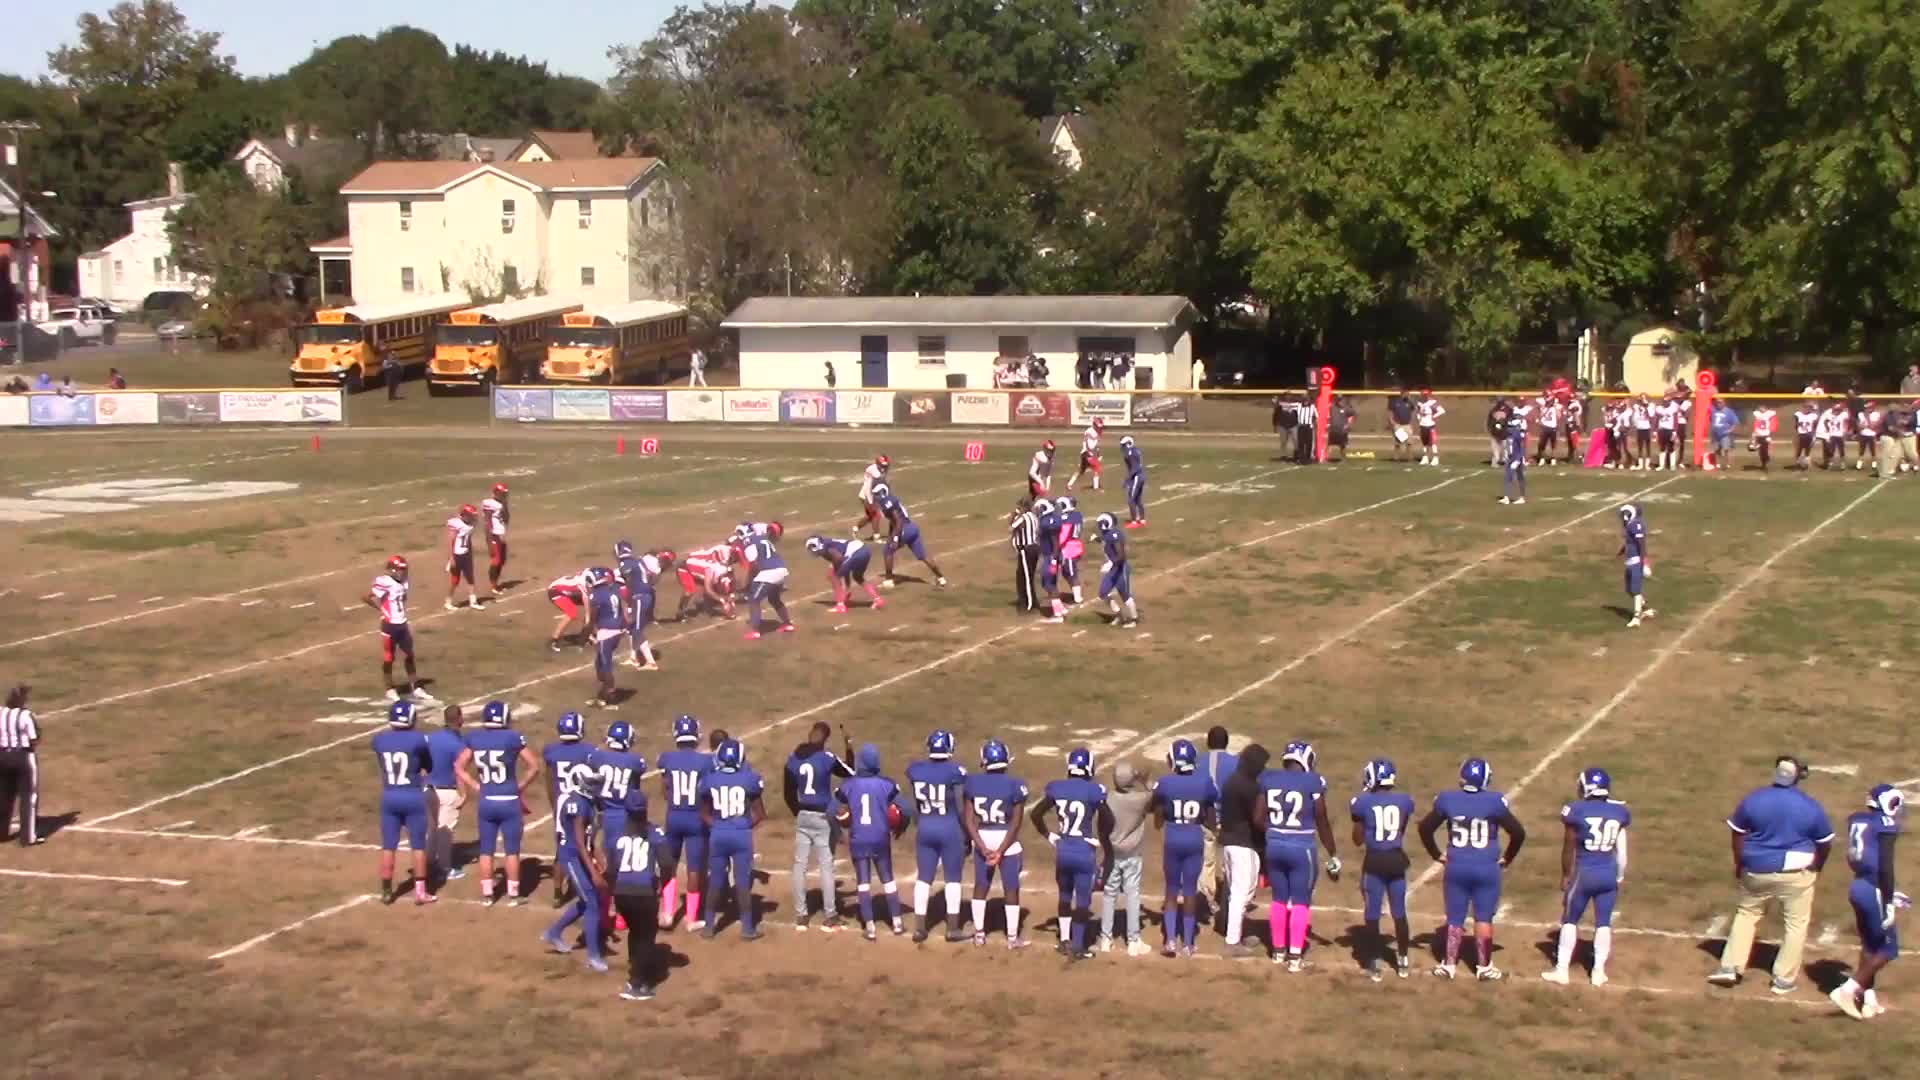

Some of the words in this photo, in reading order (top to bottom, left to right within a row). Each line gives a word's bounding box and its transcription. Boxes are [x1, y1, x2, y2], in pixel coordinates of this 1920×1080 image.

[642, 439, 656, 453] G
[967, 444, 981, 459] 10
[383, 752, 410, 784] 12
[474, 750, 505, 784] 55
[556, 761, 574, 793] 5
[599, 764, 632, 799] 24
[799, 763, 816, 794] 2
[672, 770, 698, 805] 14
[711, 786, 745, 819] 48
[914, 782, 946, 815] 54
[860, 794, 872, 824] 1
[974, 797, 1005, 824] 56
[1055, 799, 1084, 836] 32
[1267, 790, 1303, 827] 52
[1372, 805, 1400, 841] 19
[1451, 816, 1489, 848] 50
[1584, 817, 1620, 852] 30
